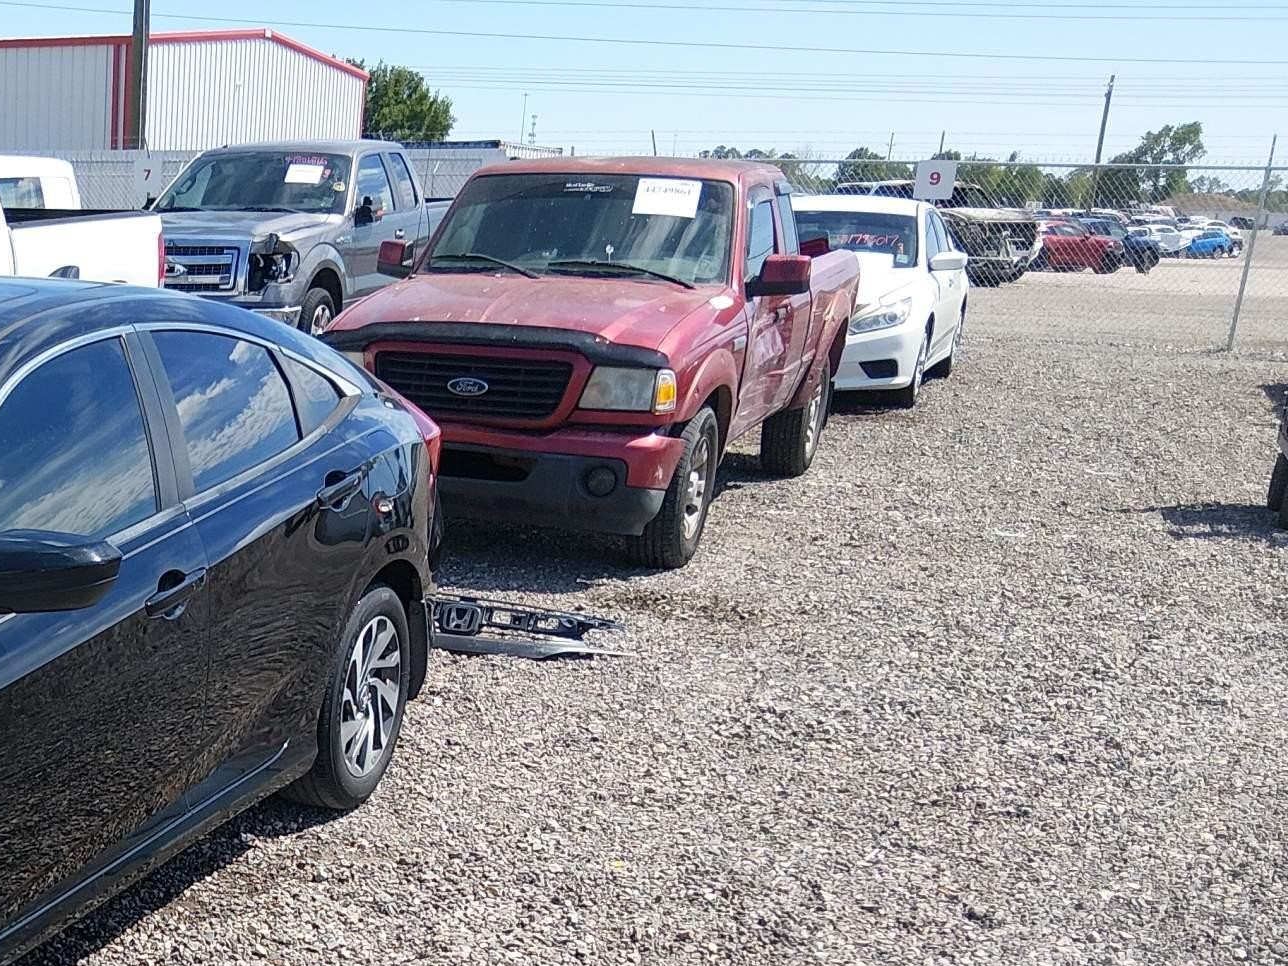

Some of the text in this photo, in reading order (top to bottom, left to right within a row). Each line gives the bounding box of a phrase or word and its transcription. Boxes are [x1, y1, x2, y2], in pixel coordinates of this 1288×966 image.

[143, 168, 152, 181] 7
[929, 171, 941, 186] 9
[453, 379, 482, 392] Ford
